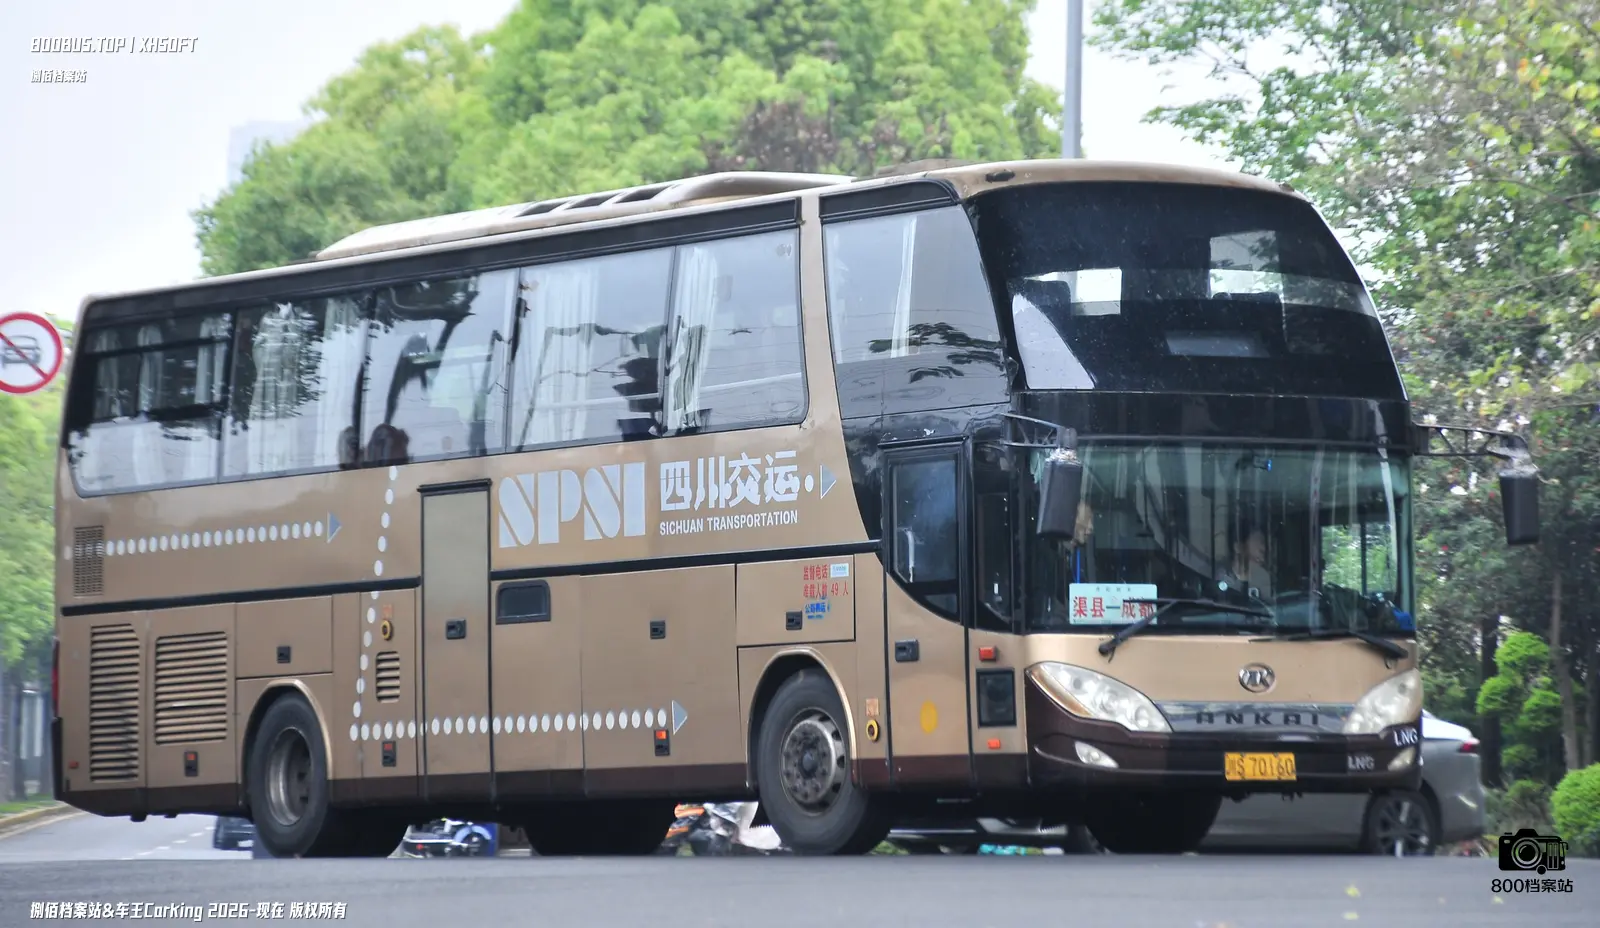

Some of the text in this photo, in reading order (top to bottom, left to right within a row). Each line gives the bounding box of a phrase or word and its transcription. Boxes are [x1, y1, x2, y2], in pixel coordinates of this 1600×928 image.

[660, 451, 800, 512] 四川交运
[499, 461, 646, 549] SPSI
[659, 509, 799, 537] SICHUAN TRANSPORTATION
[1195, 711, 1320, 726] ANKAI
[1393, 728, 1419, 746] LNG
[1249, 755, 1296, 776] 70160
[1347, 755, 1375, 770] LNG
